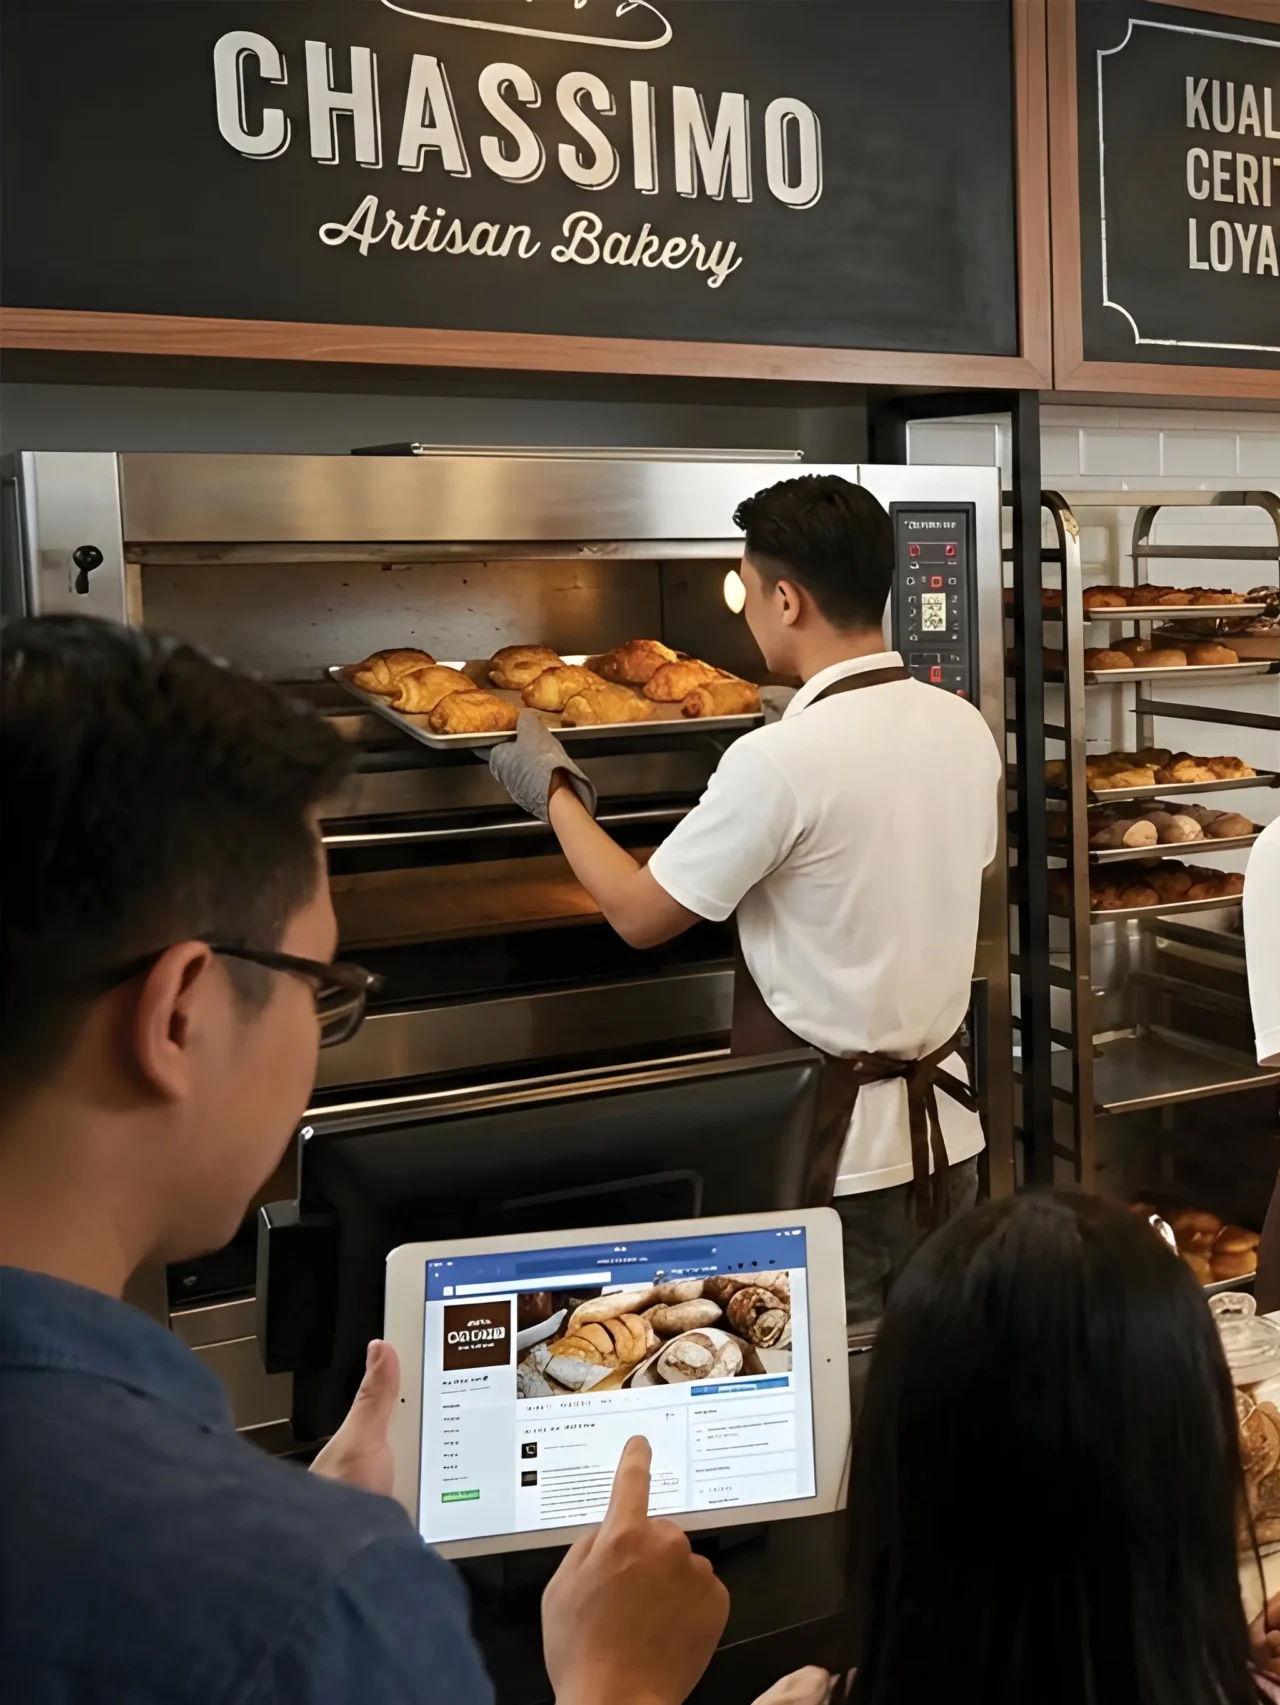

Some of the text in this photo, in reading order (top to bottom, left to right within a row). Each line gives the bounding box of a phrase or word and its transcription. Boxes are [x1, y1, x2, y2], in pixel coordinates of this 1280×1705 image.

[213, 30, 823, 210] CHASSIMO
[318, 194, 743, 289] Artisan Bakery
